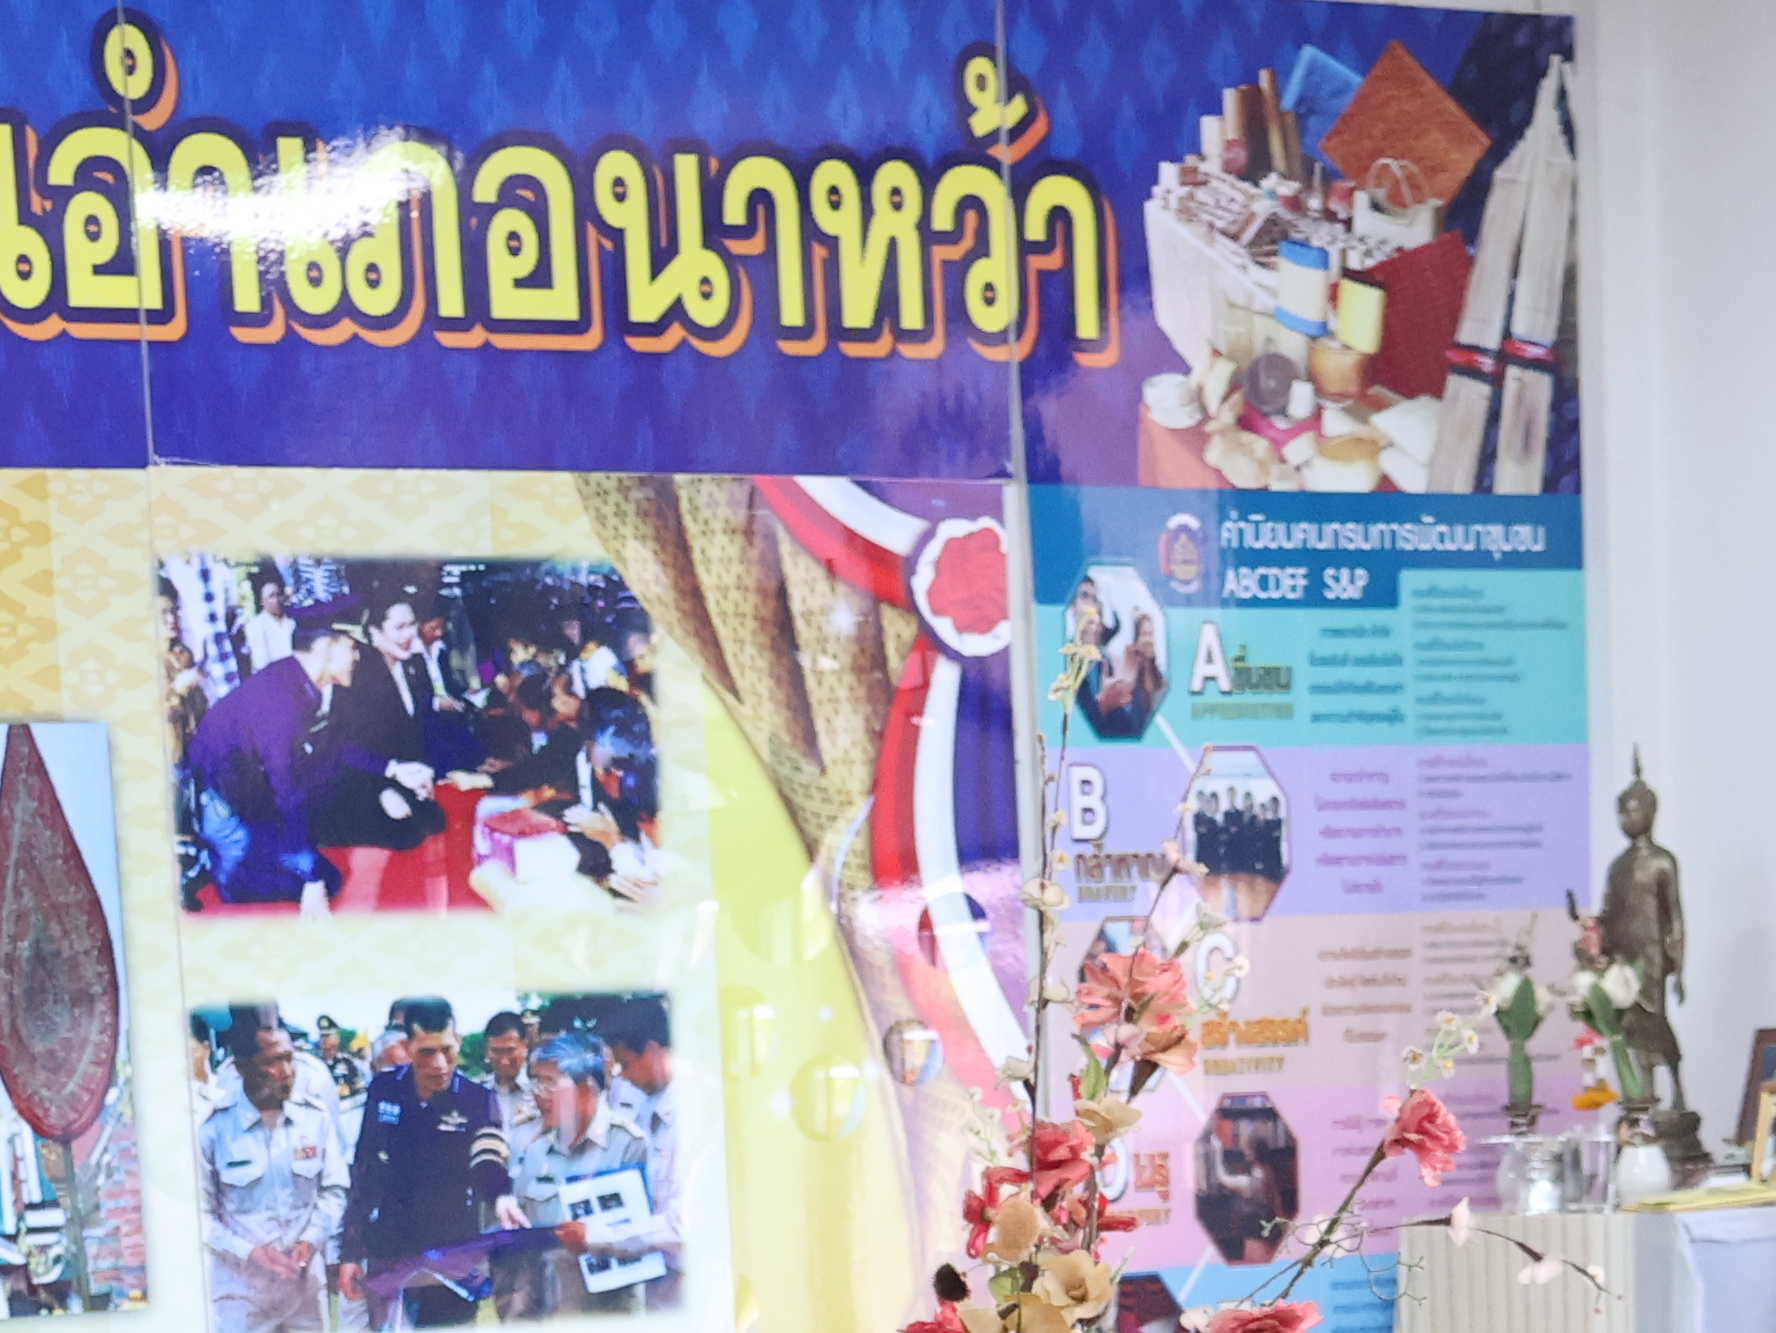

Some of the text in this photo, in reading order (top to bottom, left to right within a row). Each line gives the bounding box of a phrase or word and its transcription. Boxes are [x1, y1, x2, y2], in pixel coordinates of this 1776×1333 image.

[1222, 567, 1370, 600] ABCDEF S&P
[1189, 620, 1233, 695] A
[1069, 764, 1108, 842] B
